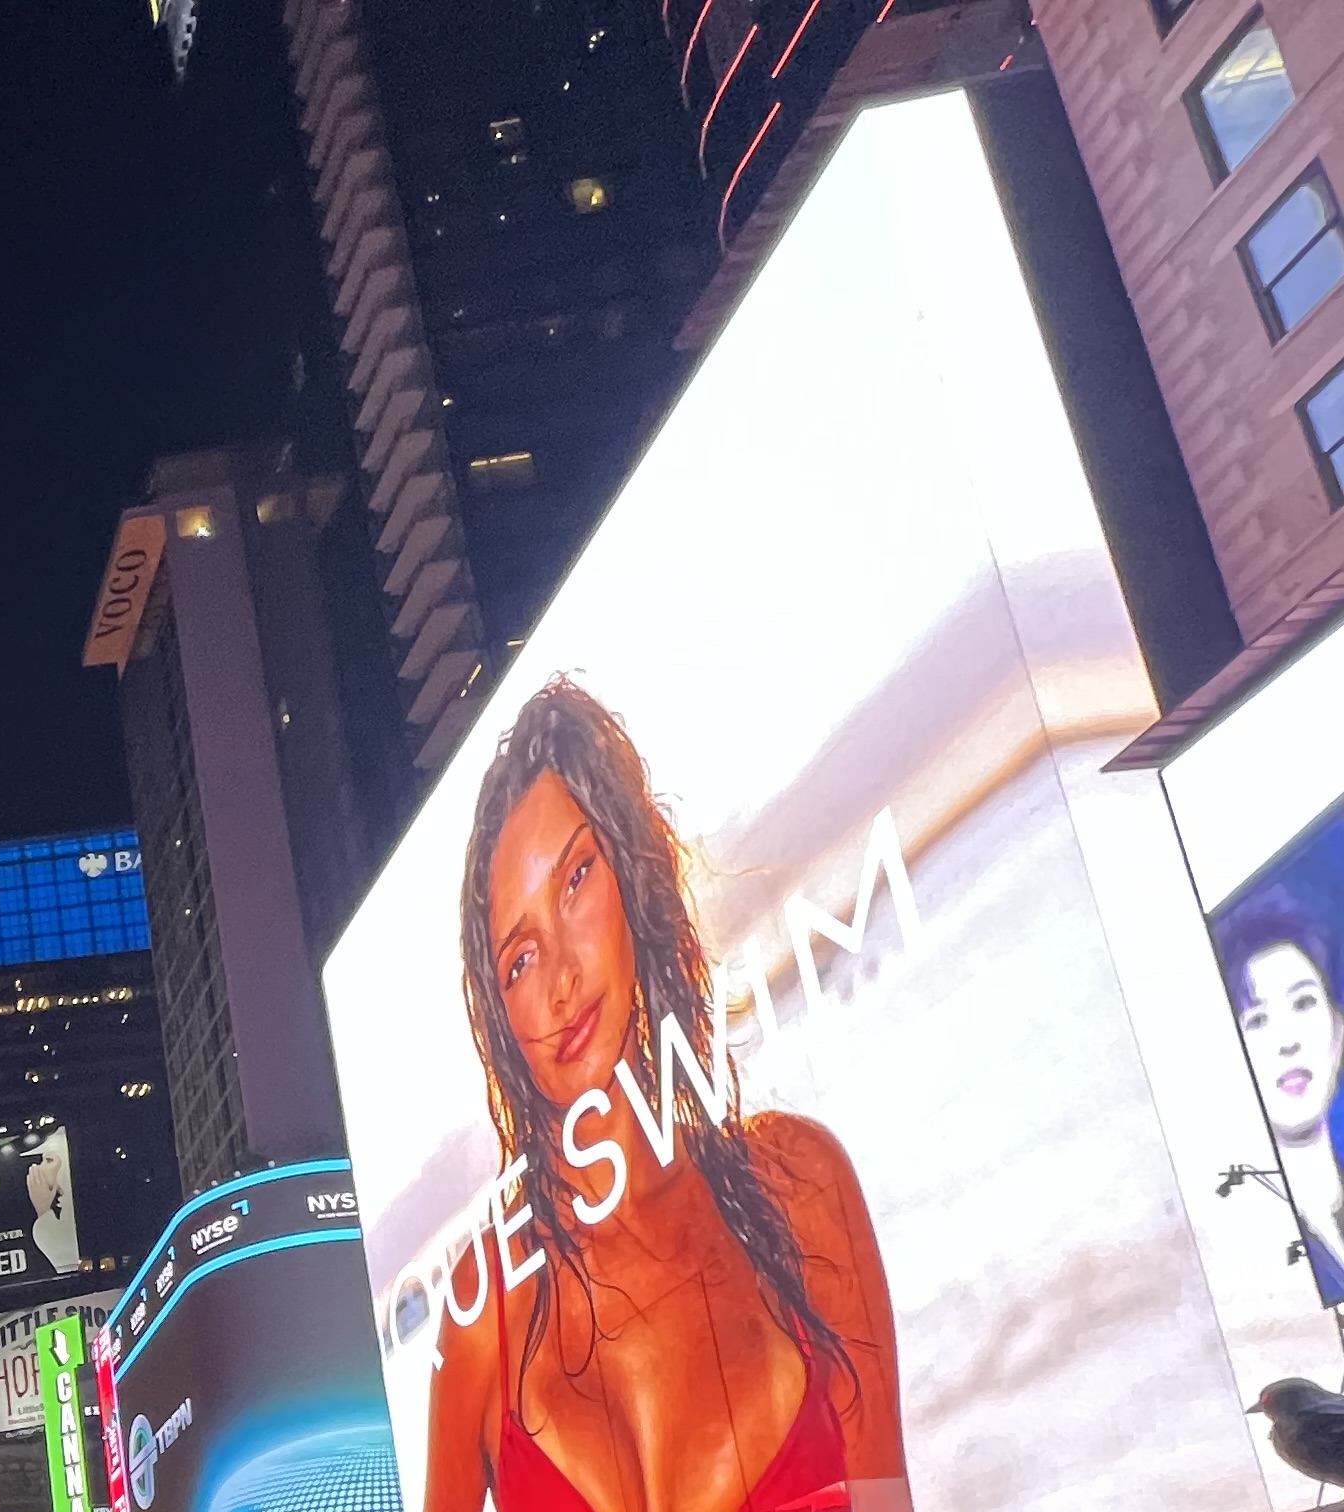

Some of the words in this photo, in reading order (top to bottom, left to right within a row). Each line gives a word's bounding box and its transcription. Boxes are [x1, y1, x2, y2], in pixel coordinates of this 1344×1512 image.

[306, 1192, 358, 1214] NYS
[65, 1304, 115, 1328] SHO
[154, 1397, 194, 1456] TBPN
